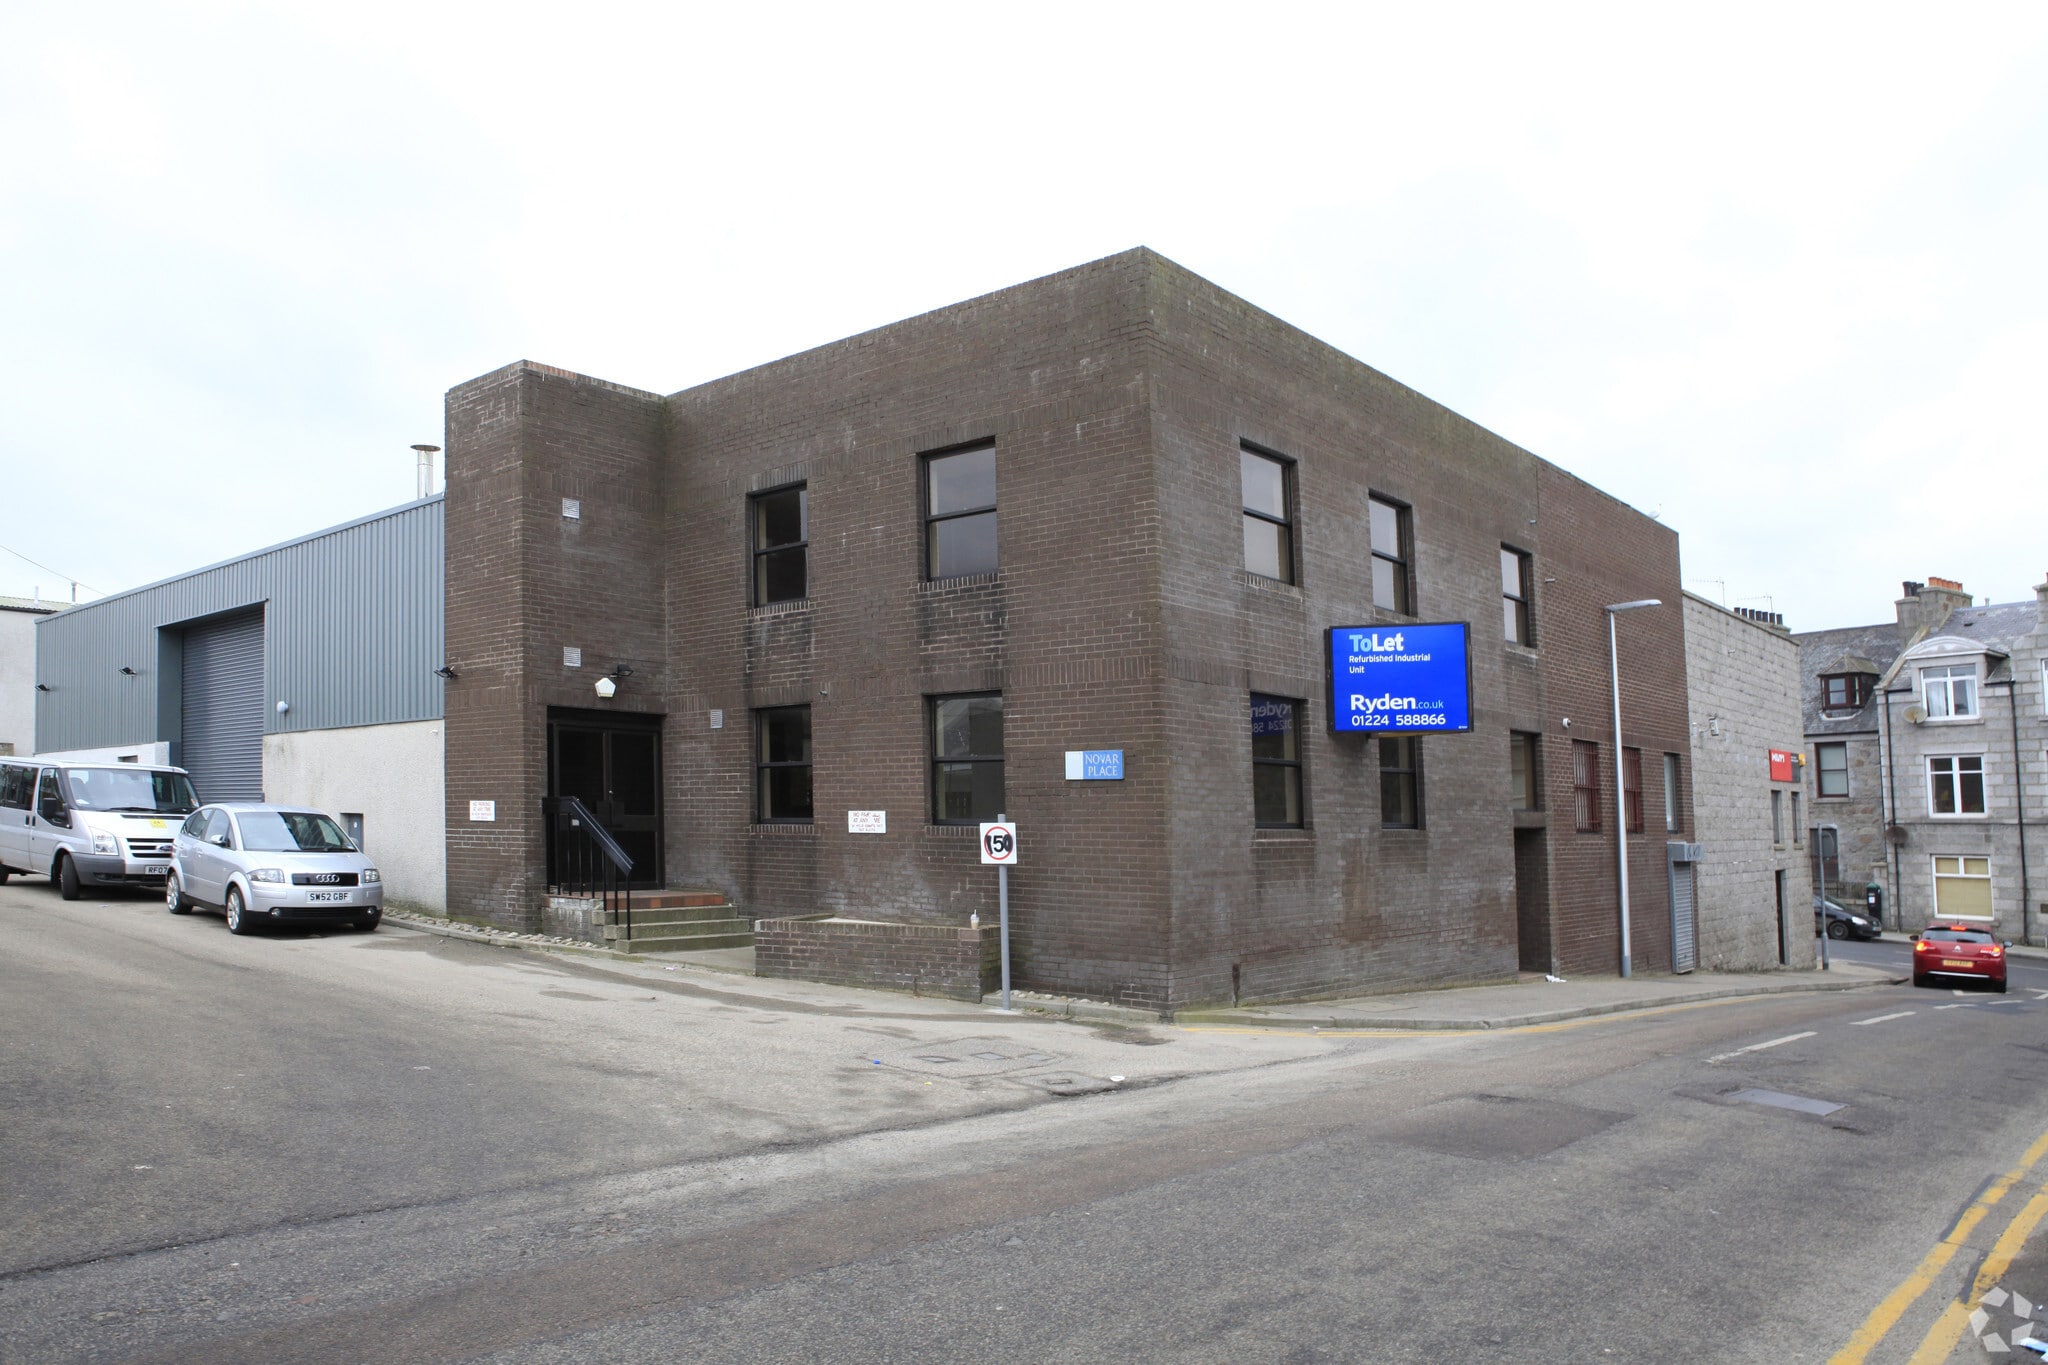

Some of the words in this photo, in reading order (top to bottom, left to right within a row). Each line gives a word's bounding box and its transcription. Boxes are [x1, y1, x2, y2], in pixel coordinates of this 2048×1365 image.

[1349, 654, 1393, 663] Refurbished
[1395, 653, 1431, 662] Industrial
[1349, 665, 1365, 674] Unit
[1351, 714, 1390, 726] 01224
[1395, 713, 1446, 726] 588866
[1085, 753, 1120, 765] NOVAR
[1088, 765, 1118, 777] PLACE
[148, 866, 168, 874] RF07
[310, 892, 332, 901] SW52
[333, 892, 349, 901] GBF
